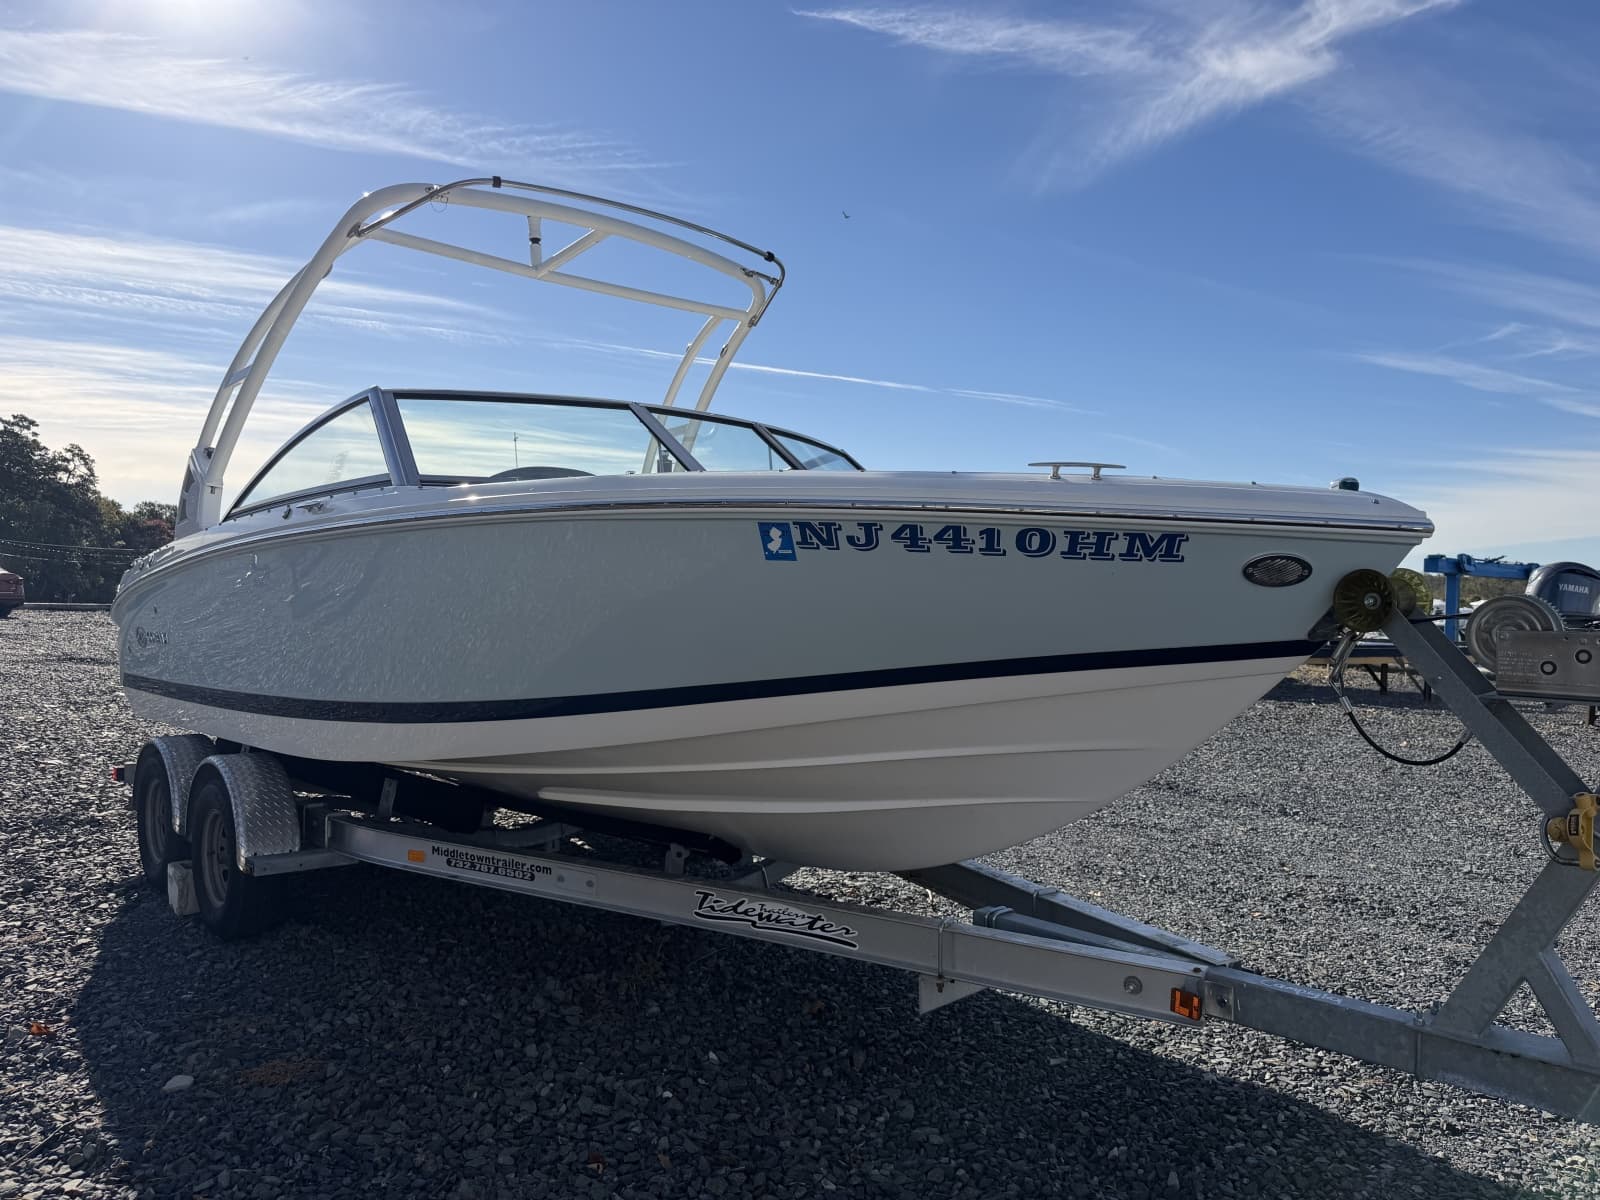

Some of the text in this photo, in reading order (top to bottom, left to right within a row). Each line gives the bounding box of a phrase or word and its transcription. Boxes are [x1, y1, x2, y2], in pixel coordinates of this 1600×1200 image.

[1559, 583, 1589, 594] YAMAHA
[431, 846, 552, 875] Middletowntrailer.com
[449, 859, 533, 880] 732.787.6502
[695, 891, 857, 935] Tidewater
